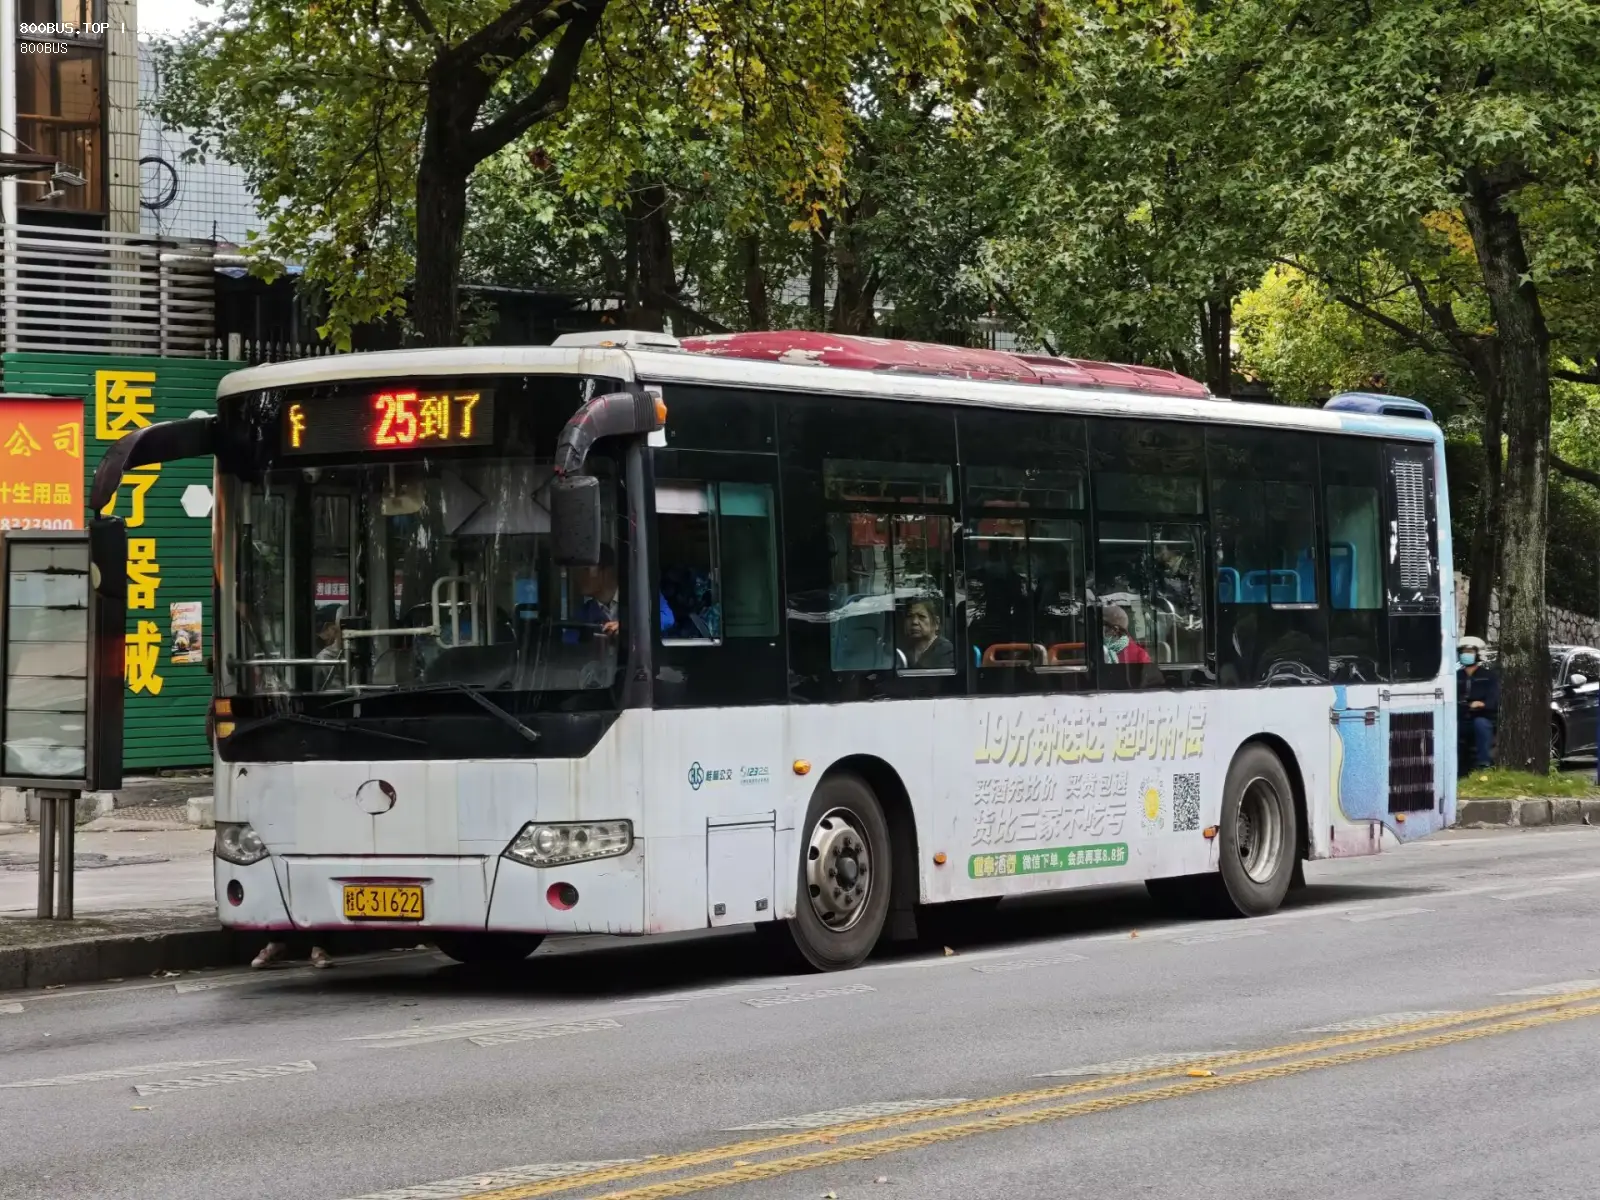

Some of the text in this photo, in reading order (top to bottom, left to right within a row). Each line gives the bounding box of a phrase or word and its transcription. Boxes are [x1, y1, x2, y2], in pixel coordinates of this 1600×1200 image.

[4, 422, 81, 458] 公司
[974, 774, 1058, 805] 买酒先比价
[971, 802, 1128, 846] 货比三家不吃亏
